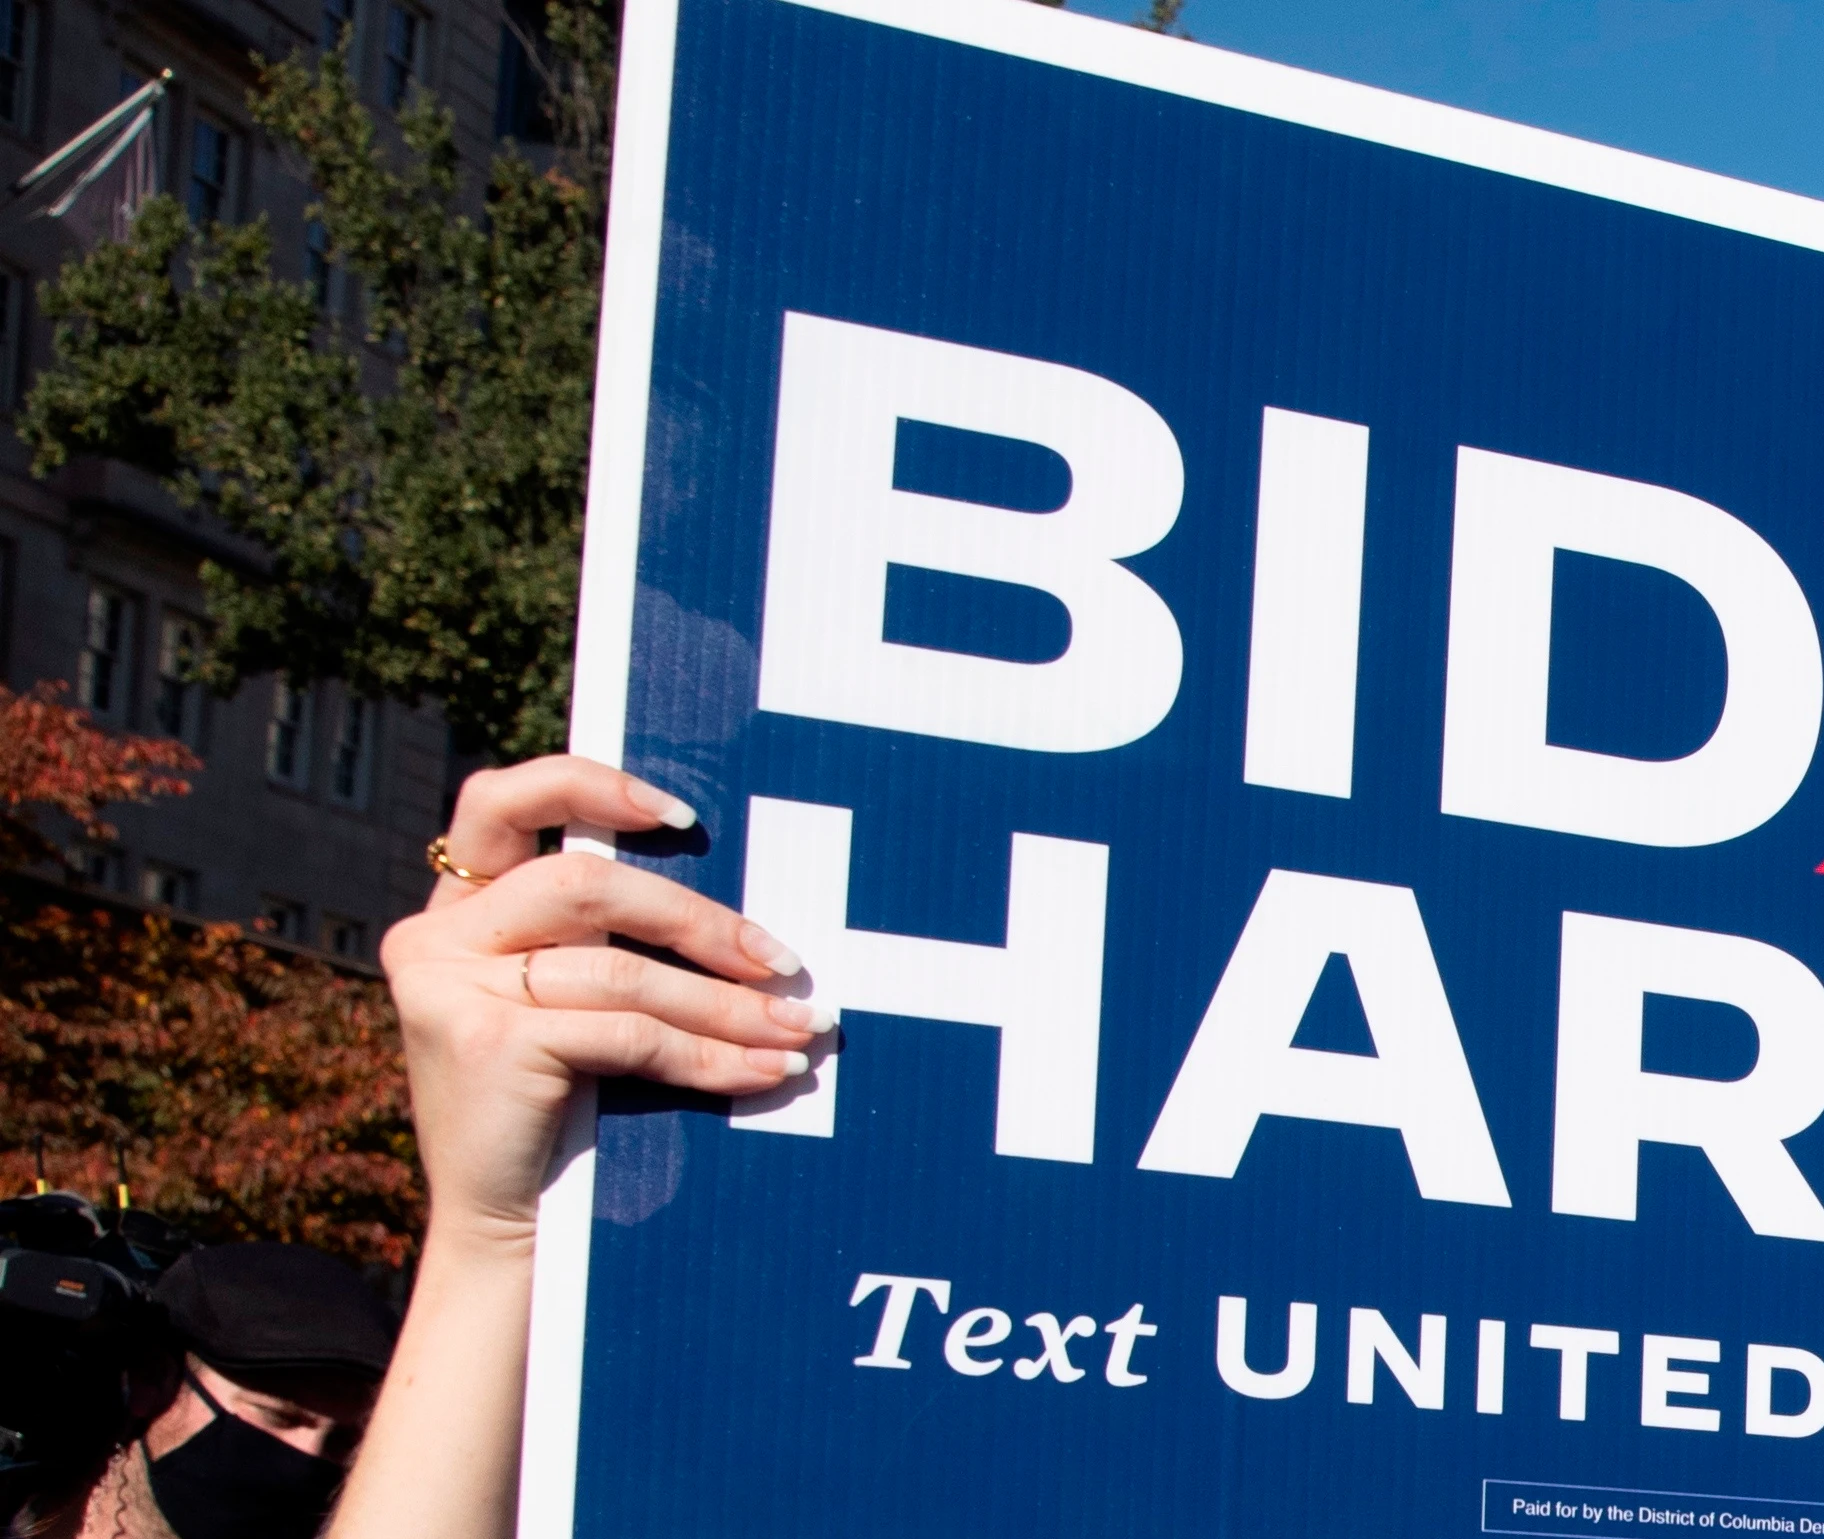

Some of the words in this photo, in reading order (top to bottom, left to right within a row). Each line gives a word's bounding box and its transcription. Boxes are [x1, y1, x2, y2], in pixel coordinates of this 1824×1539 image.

[849, 1272, 1158, 1389] Text
[1513, 1499, 1550, 1516] Paid
[1556, 1501, 1578, 1518] for
[1583, 1503, 1603, 1523] by
[1608, 1506, 1633, 1522] the
[1639, 1507, 1694, 1526] District
[1699, 1512, 1715, 1527] of
[1719, 1513, 1795, 1532] Columbia
